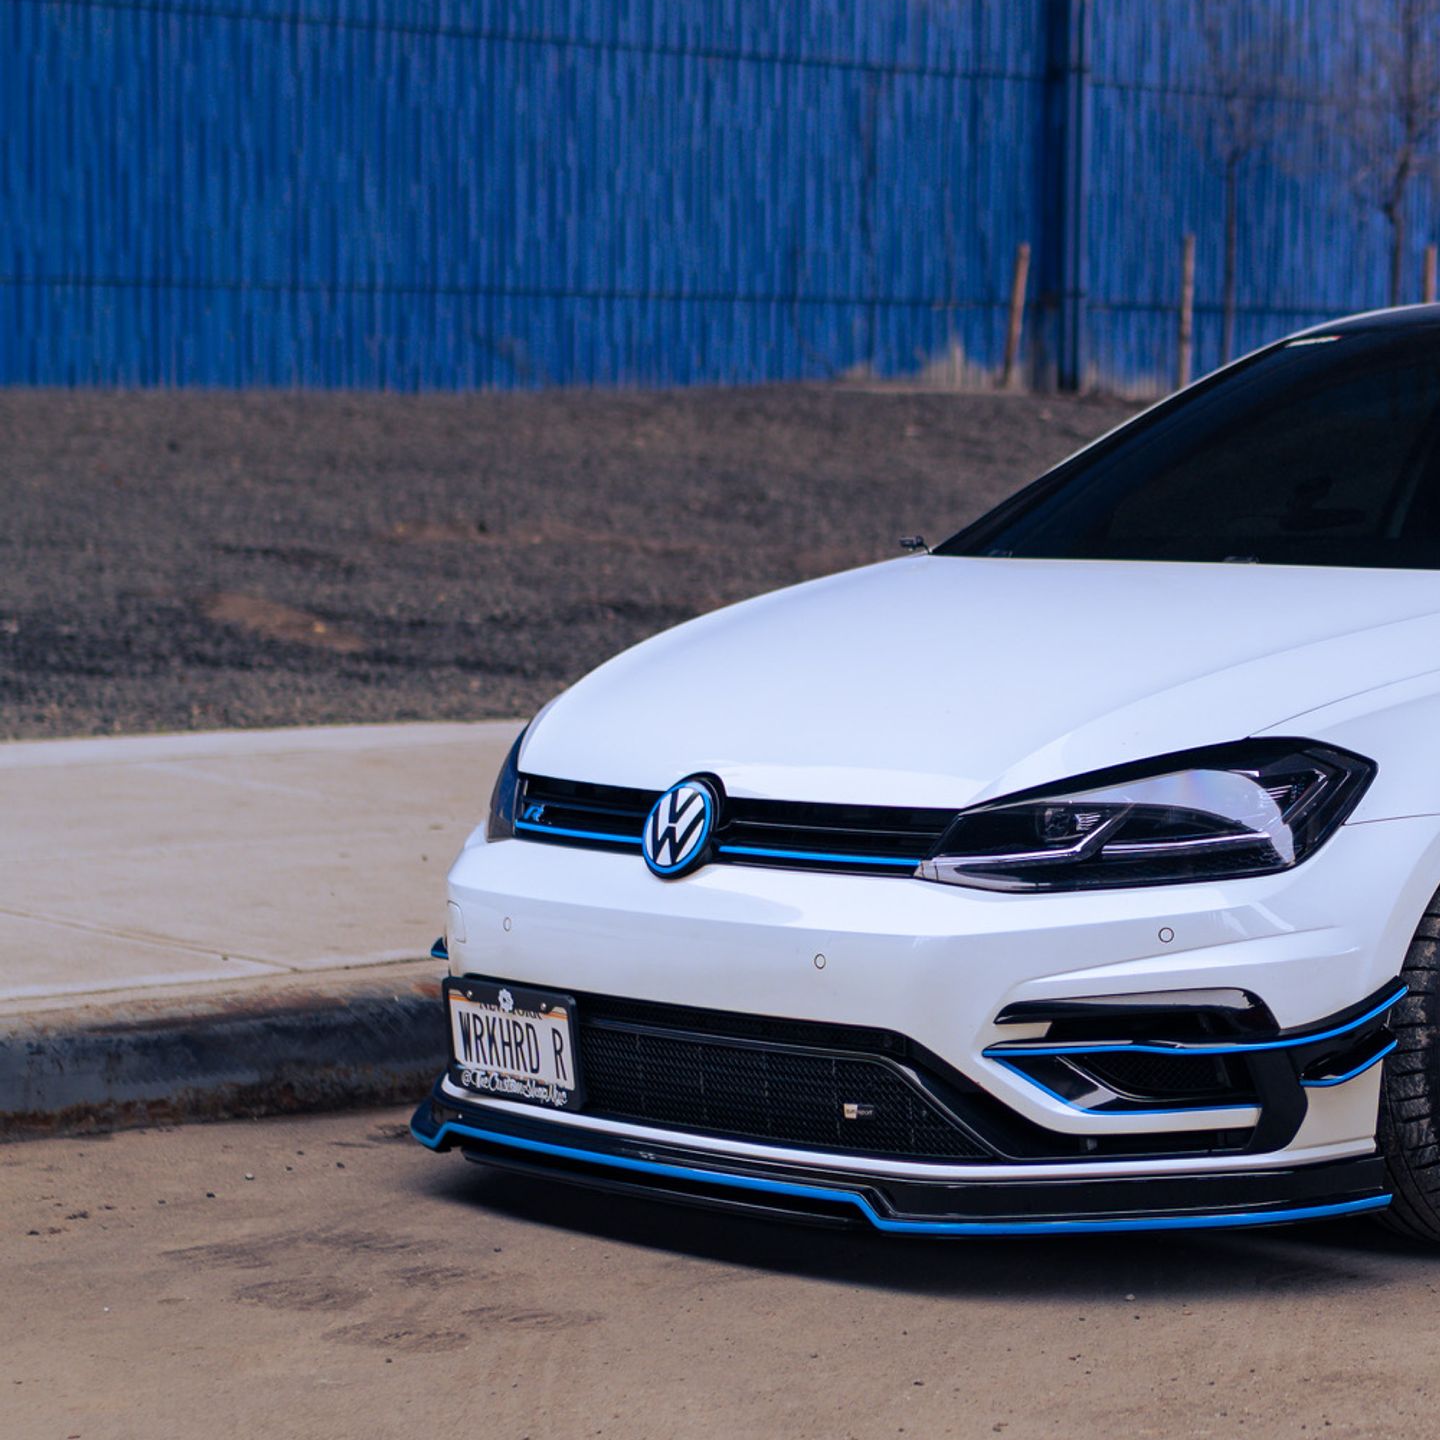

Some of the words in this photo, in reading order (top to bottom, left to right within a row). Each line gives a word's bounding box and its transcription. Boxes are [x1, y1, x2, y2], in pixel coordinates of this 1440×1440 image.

[645, 786, 707, 867] VW
[458, 1010, 541, 1075] WRKHRD
[551, 1026, 568, 1082] R
